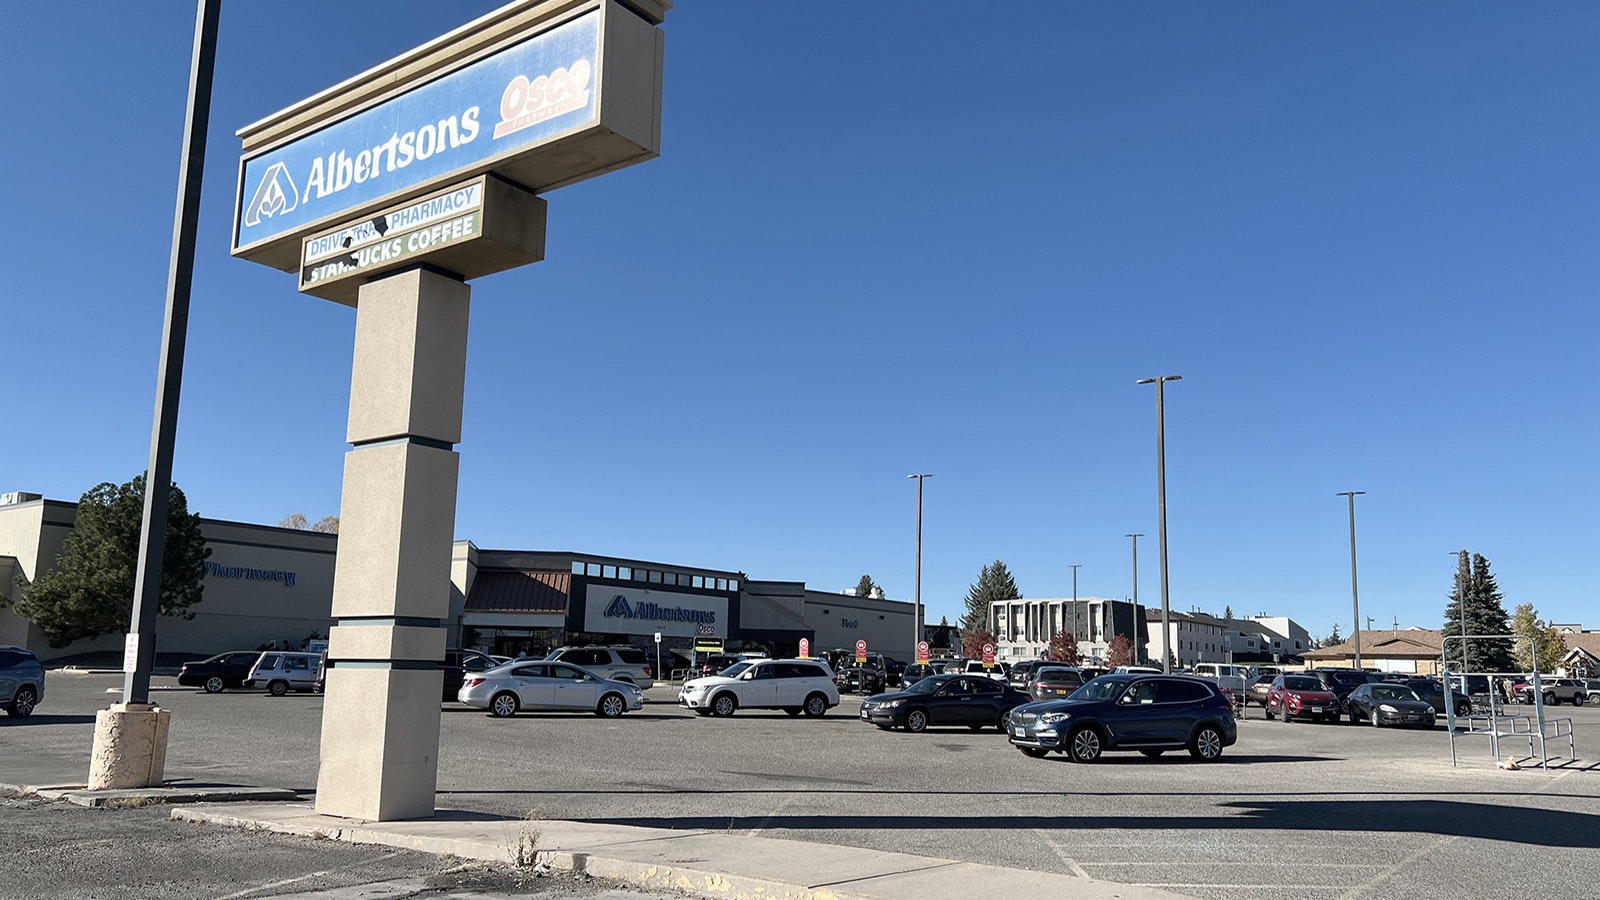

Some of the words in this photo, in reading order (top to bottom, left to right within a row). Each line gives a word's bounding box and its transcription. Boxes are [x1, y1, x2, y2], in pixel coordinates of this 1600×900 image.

[302, 106, 480, 204] Albertsons
[310, 240, 401, 283] STARUCKS
[407, 215, 474, 248] COFFEE
[311, 230, 348, 256] DRIVE
[391, 187, 475, 230] PHARMACY
[204, 560, 296, 587] Pharmacy
[633, 601, 716, 625] Albertsons
